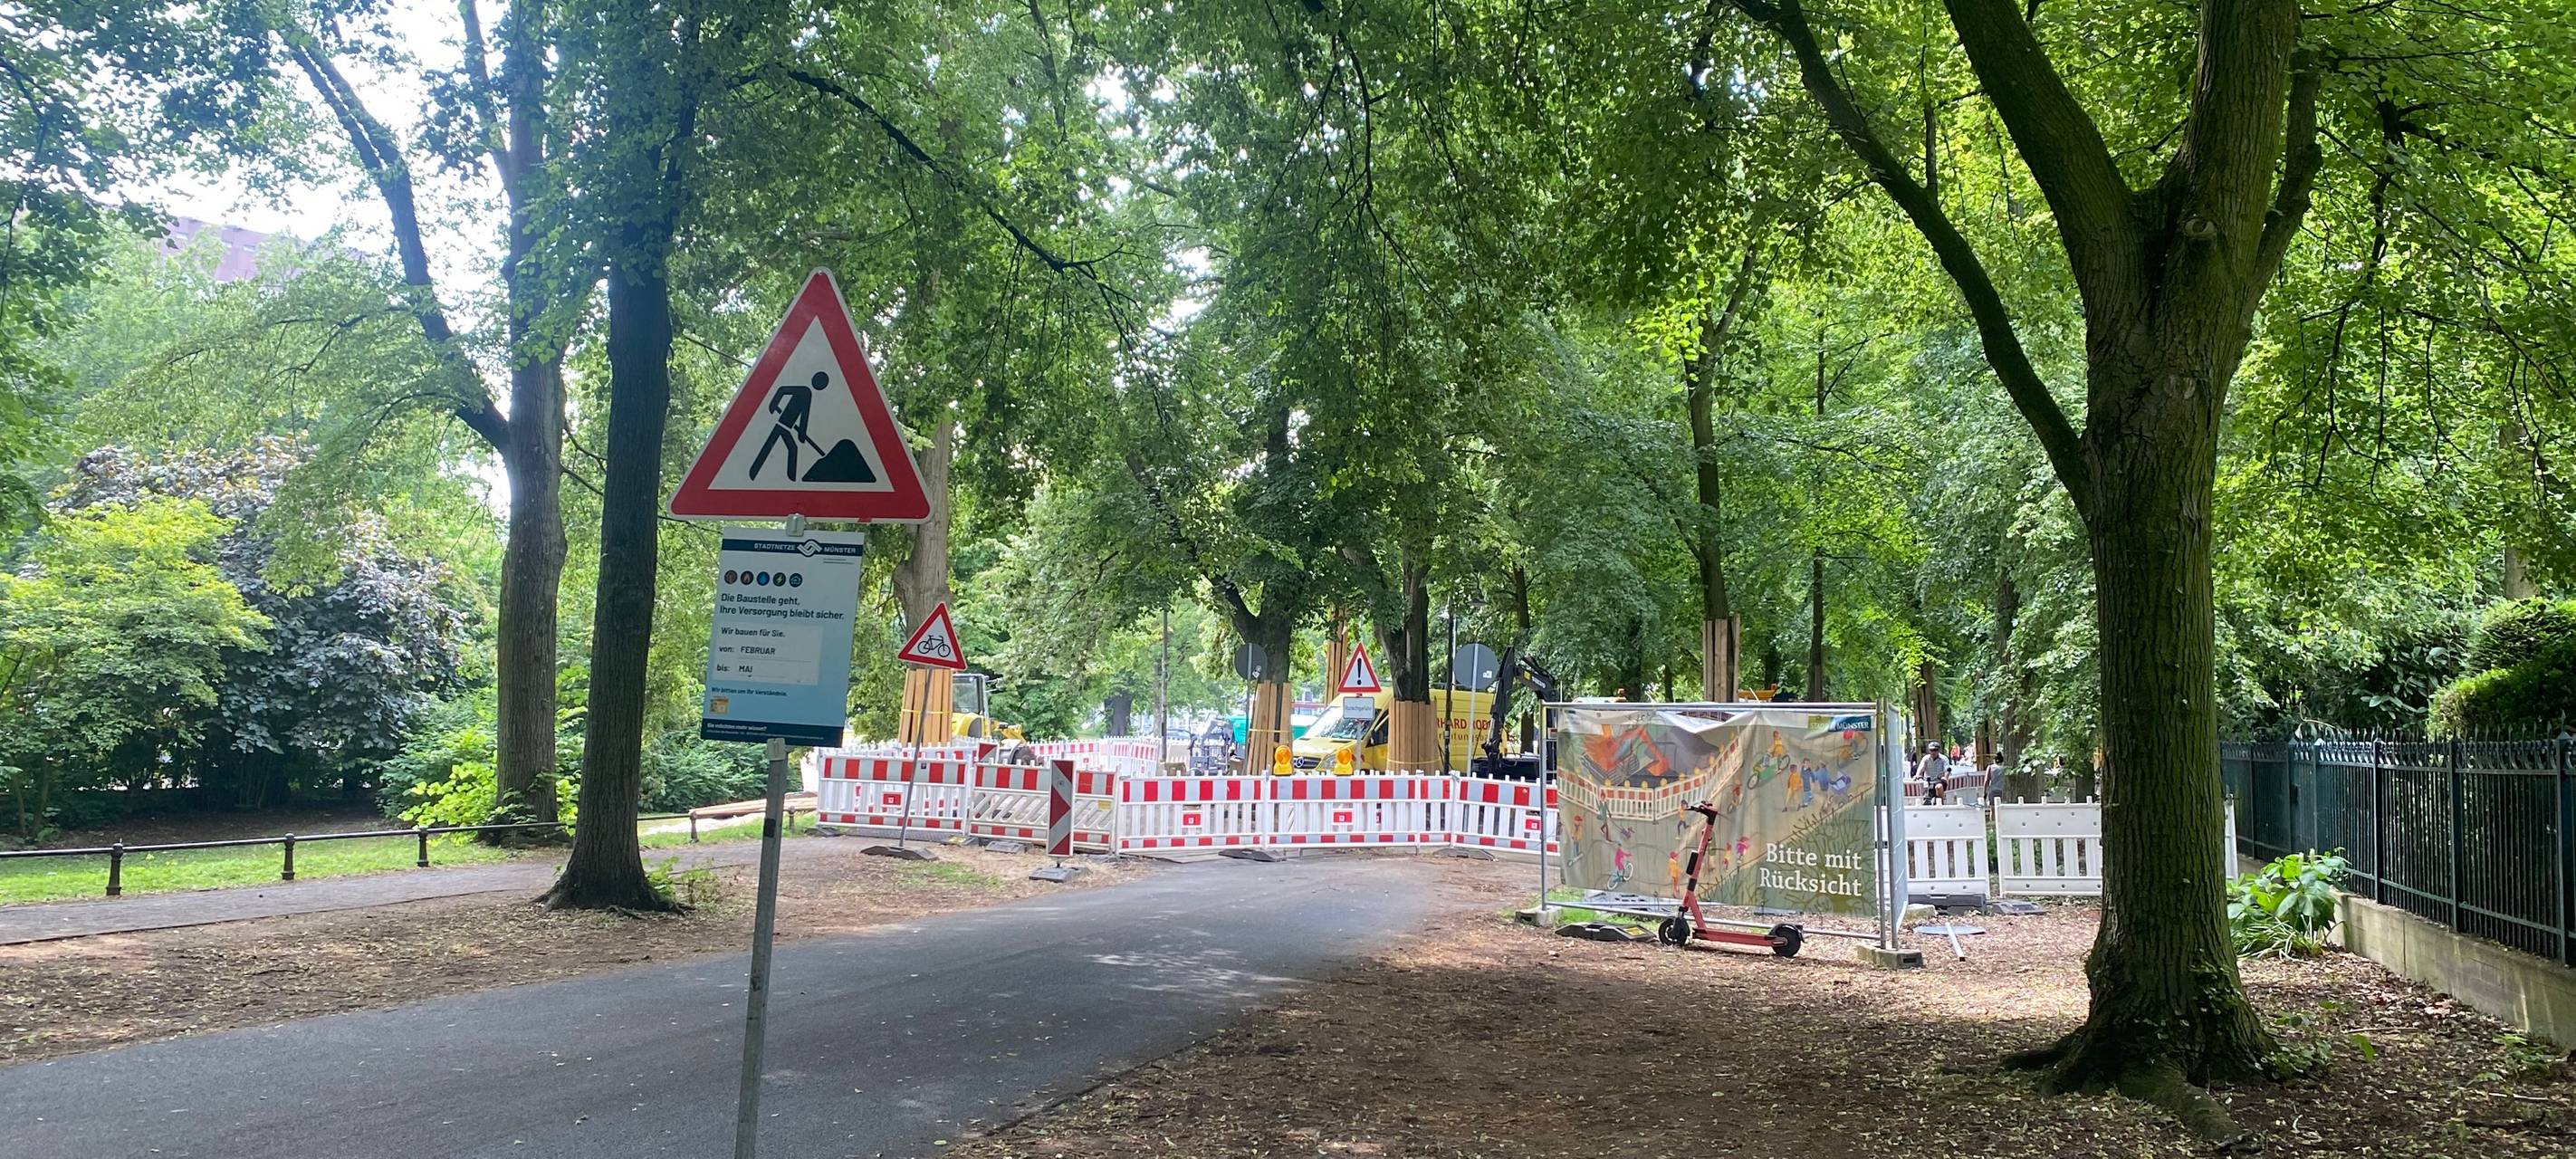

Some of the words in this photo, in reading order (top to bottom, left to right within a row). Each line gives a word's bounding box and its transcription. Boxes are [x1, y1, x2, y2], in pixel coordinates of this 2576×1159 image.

[753, 542, 796, 551] STADTNETZE
[824, 546, 857, 554] MÜNSTER
[721, 593, 735, 602] Die
[736, 594, 777, 605] Baustelle
[719, 606, 737, 615] Ihre
[738, 607, 788, 619] Versorgung
[790, 608, 814, 618] bleibt
[816, 610, 845, 620] sicher.
[735, 627, 758, 637] bauen
[759, 628, 771, 637] für
[740, 646, 776, 655] FEBRUAR
[716, 664, 731, 672] bis:
[1836, 721, 1870, 729] MÜNSTER
[1766, 842, 1818, 867] Bitte
[1824, 849, 1863, 870] mit
[1759, 867, 1863, 896] Rücksicht
